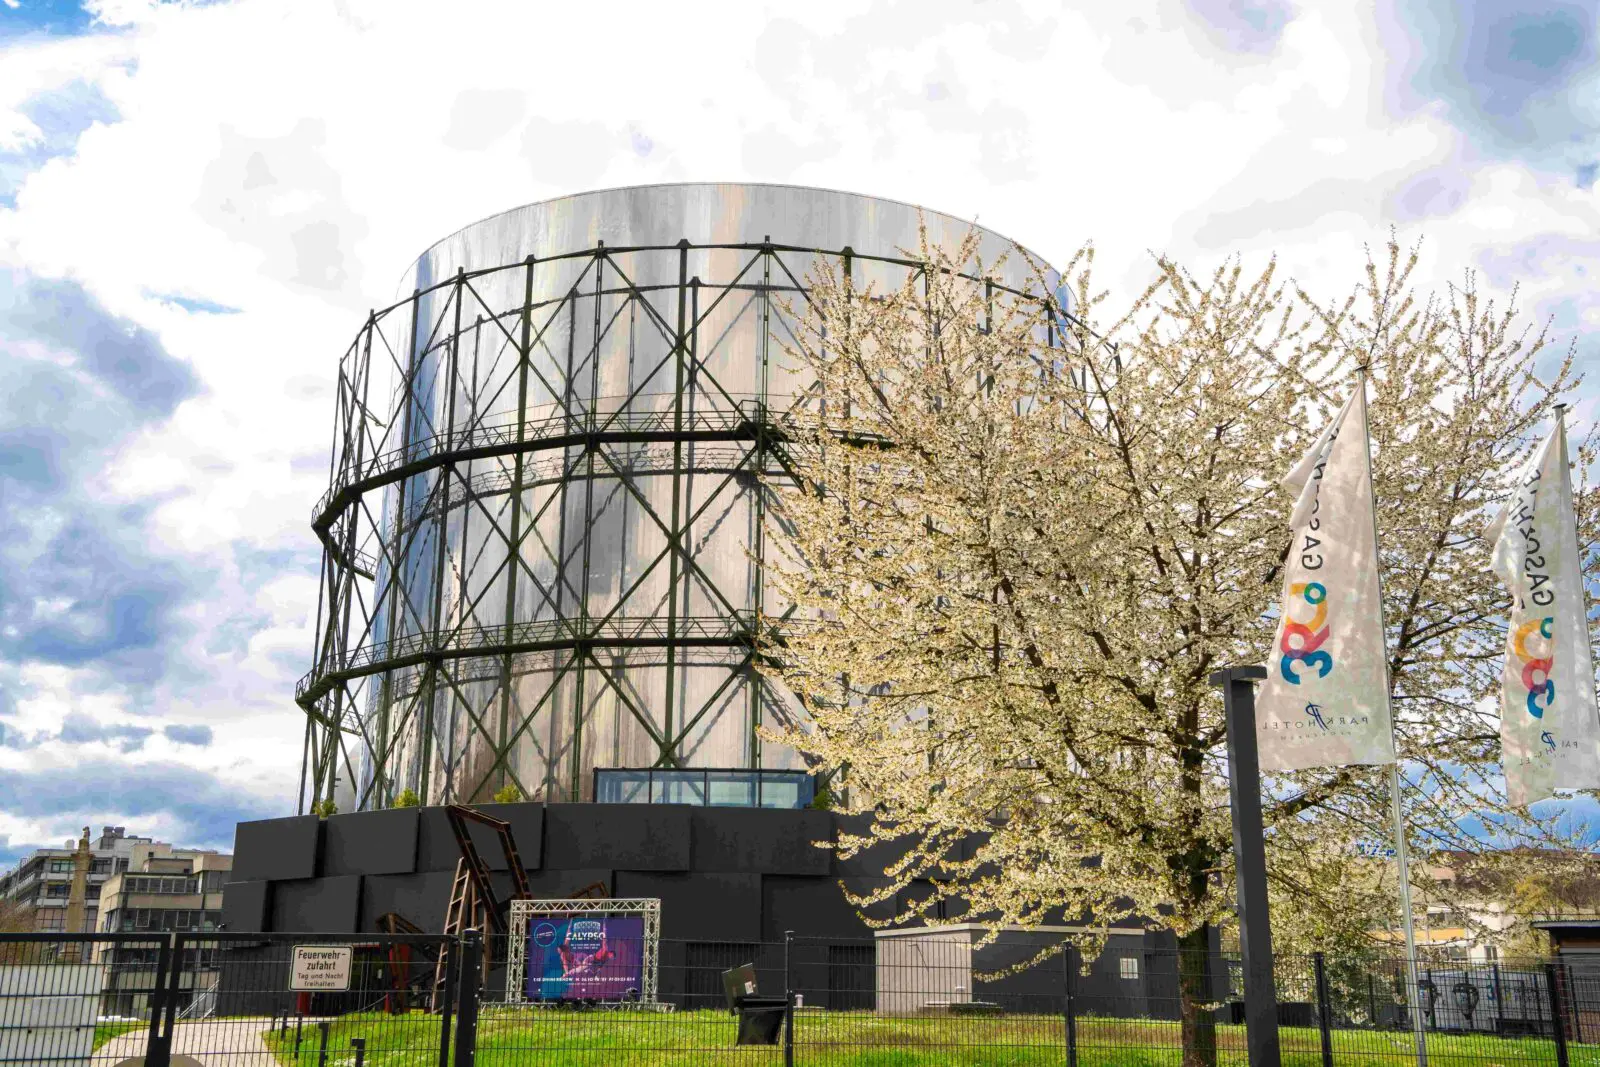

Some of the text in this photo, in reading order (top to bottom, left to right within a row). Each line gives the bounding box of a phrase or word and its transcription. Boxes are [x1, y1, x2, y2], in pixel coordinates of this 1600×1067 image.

[306, 961, 336, 971] zufahrt
[298, 972, 309, 981] Tag
[304, 980, 336, 988] freihalten
